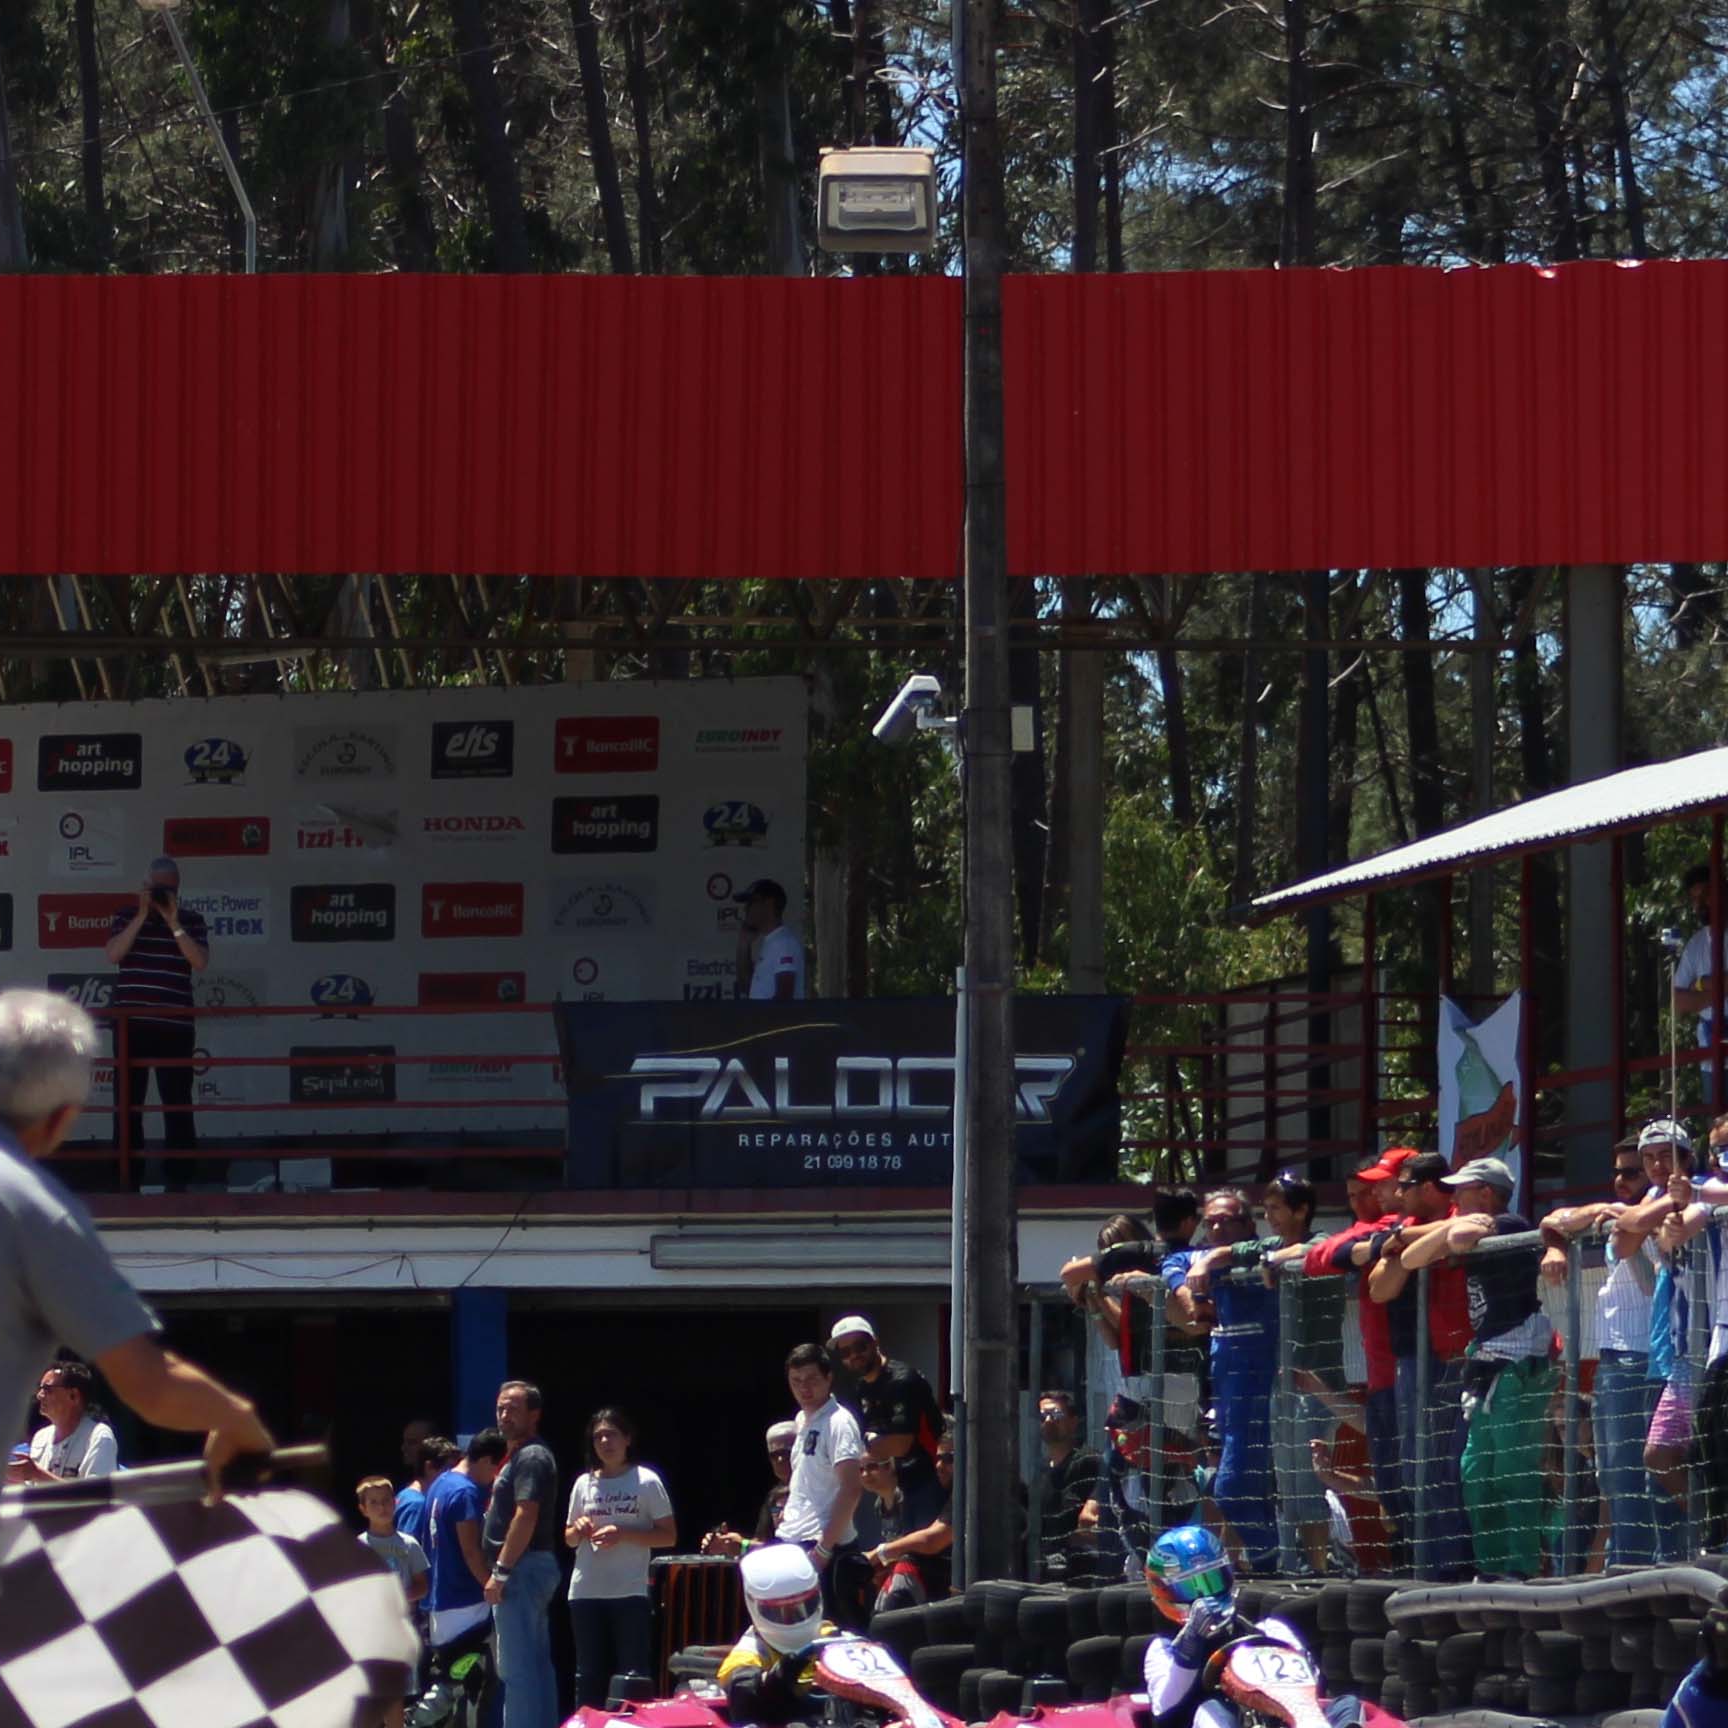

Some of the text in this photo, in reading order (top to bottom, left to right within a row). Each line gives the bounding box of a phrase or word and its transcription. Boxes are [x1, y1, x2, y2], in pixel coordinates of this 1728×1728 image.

[423, 816, 526, 832] HONDA
[69, 847, 94, 860] IPL
[197, 1083, 220, 1096] IPL
[738, 1131, 953, 1149] REPARAÇÕES AUT
[803, 1156, 821, 1170] 21
[859, 1156, 878, 1170] 18
[883, 1156, 902, 1170] 78
[849, 1647, 888, 1676] 52
[1253, 1651, 1313, 1686] 123
